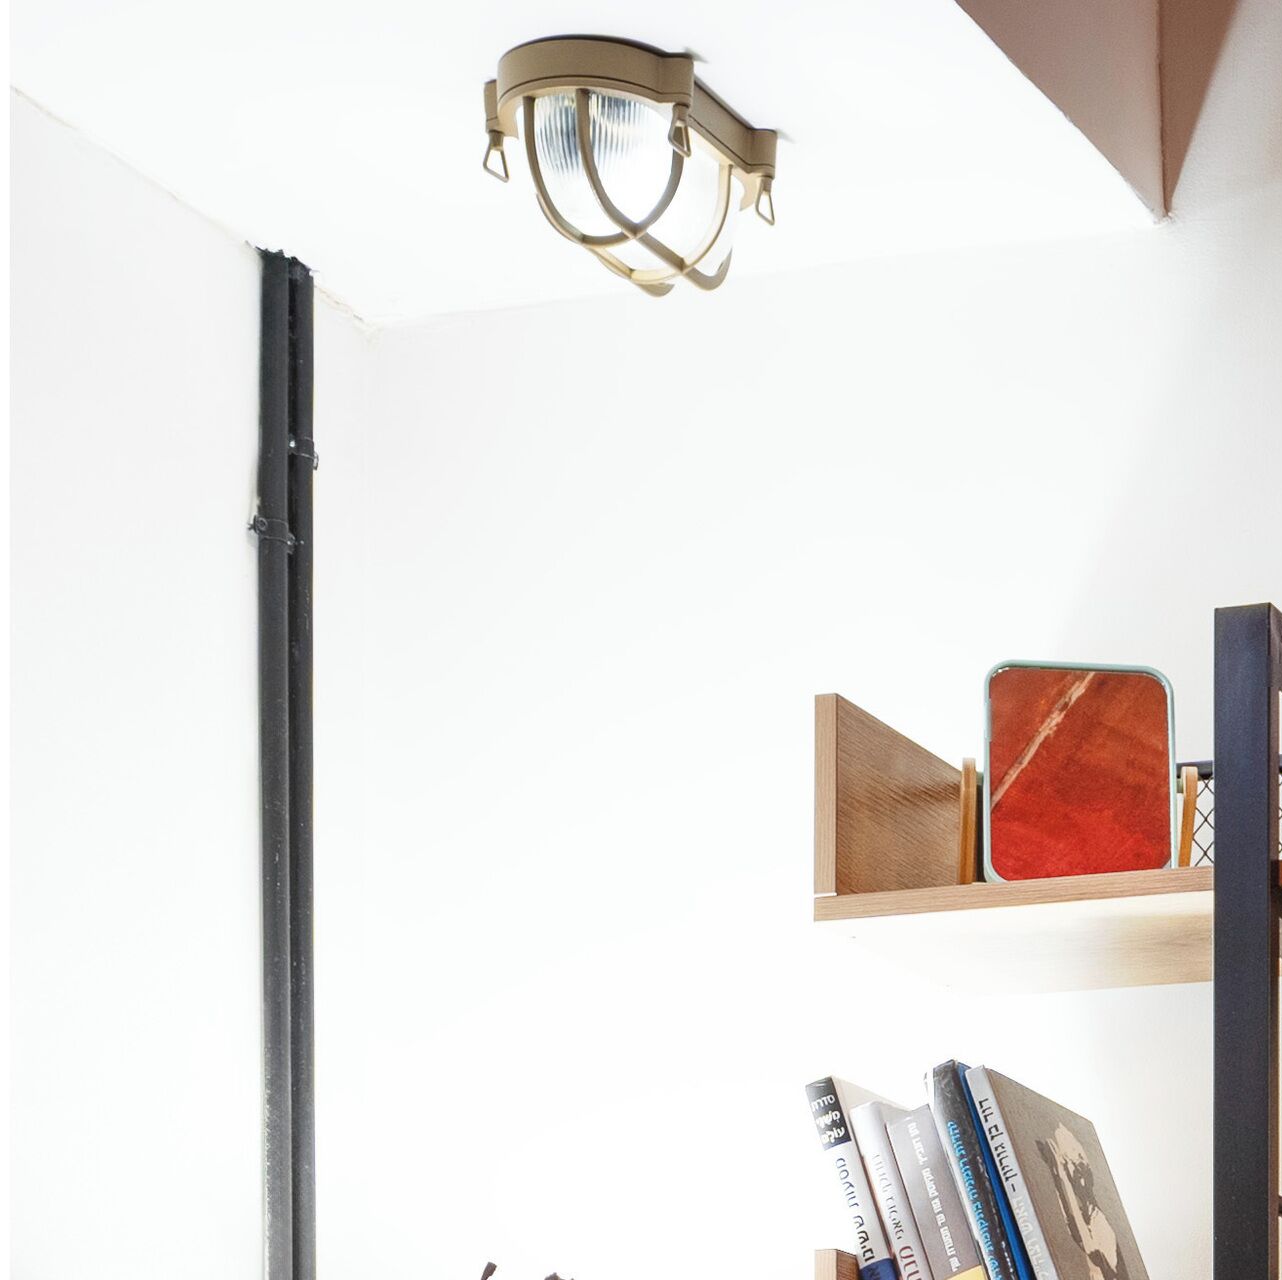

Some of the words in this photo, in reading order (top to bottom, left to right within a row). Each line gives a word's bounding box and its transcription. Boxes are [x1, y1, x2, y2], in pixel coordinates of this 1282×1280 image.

[978, 1098, 994, 1122] דוד
[988, 1124, 1004, 1141] בן
[994, 1142, 1018, 1182] גוריון
[946, 1120, 966, 1157] יהדות
[957, 1157, 978, 1199] רומניה
[970, 1200, 995, 1252] בתקומת
[837, 1158, 859, 1208] מסעות
[855, 1216, 875, 1262] ששינו
[1013, 1195, 1032, 1233] האיש
